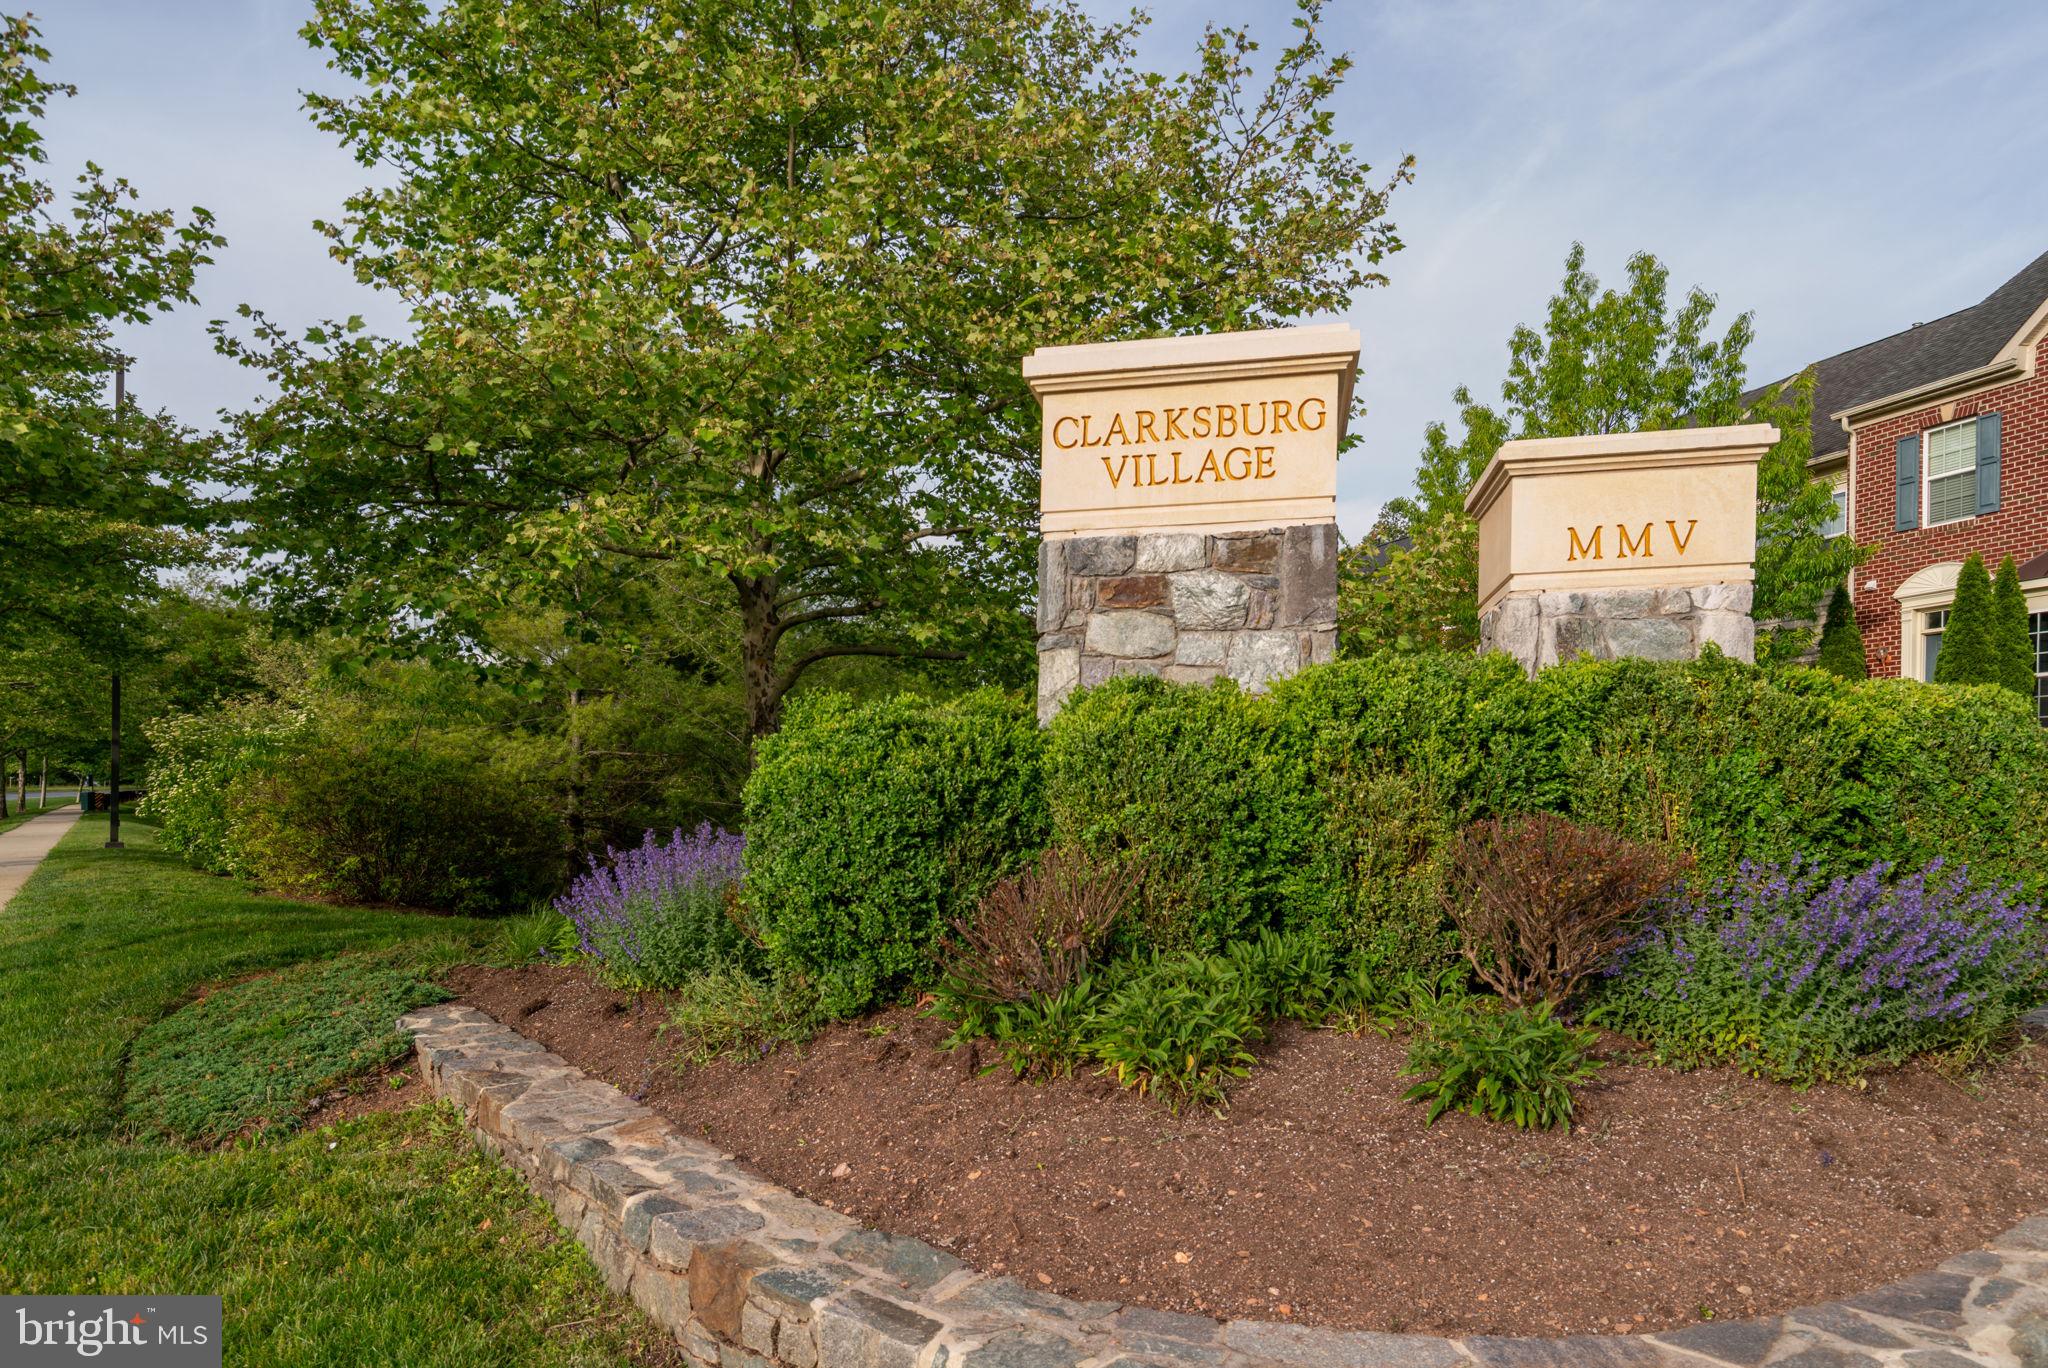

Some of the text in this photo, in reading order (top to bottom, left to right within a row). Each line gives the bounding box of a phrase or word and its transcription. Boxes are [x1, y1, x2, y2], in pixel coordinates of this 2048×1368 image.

[1053, 398, 1326, 449] CLARKSBURG
[1101, 446, 1277, 489] VILLAGE
[1567, 519, 1698, 561] MMV
